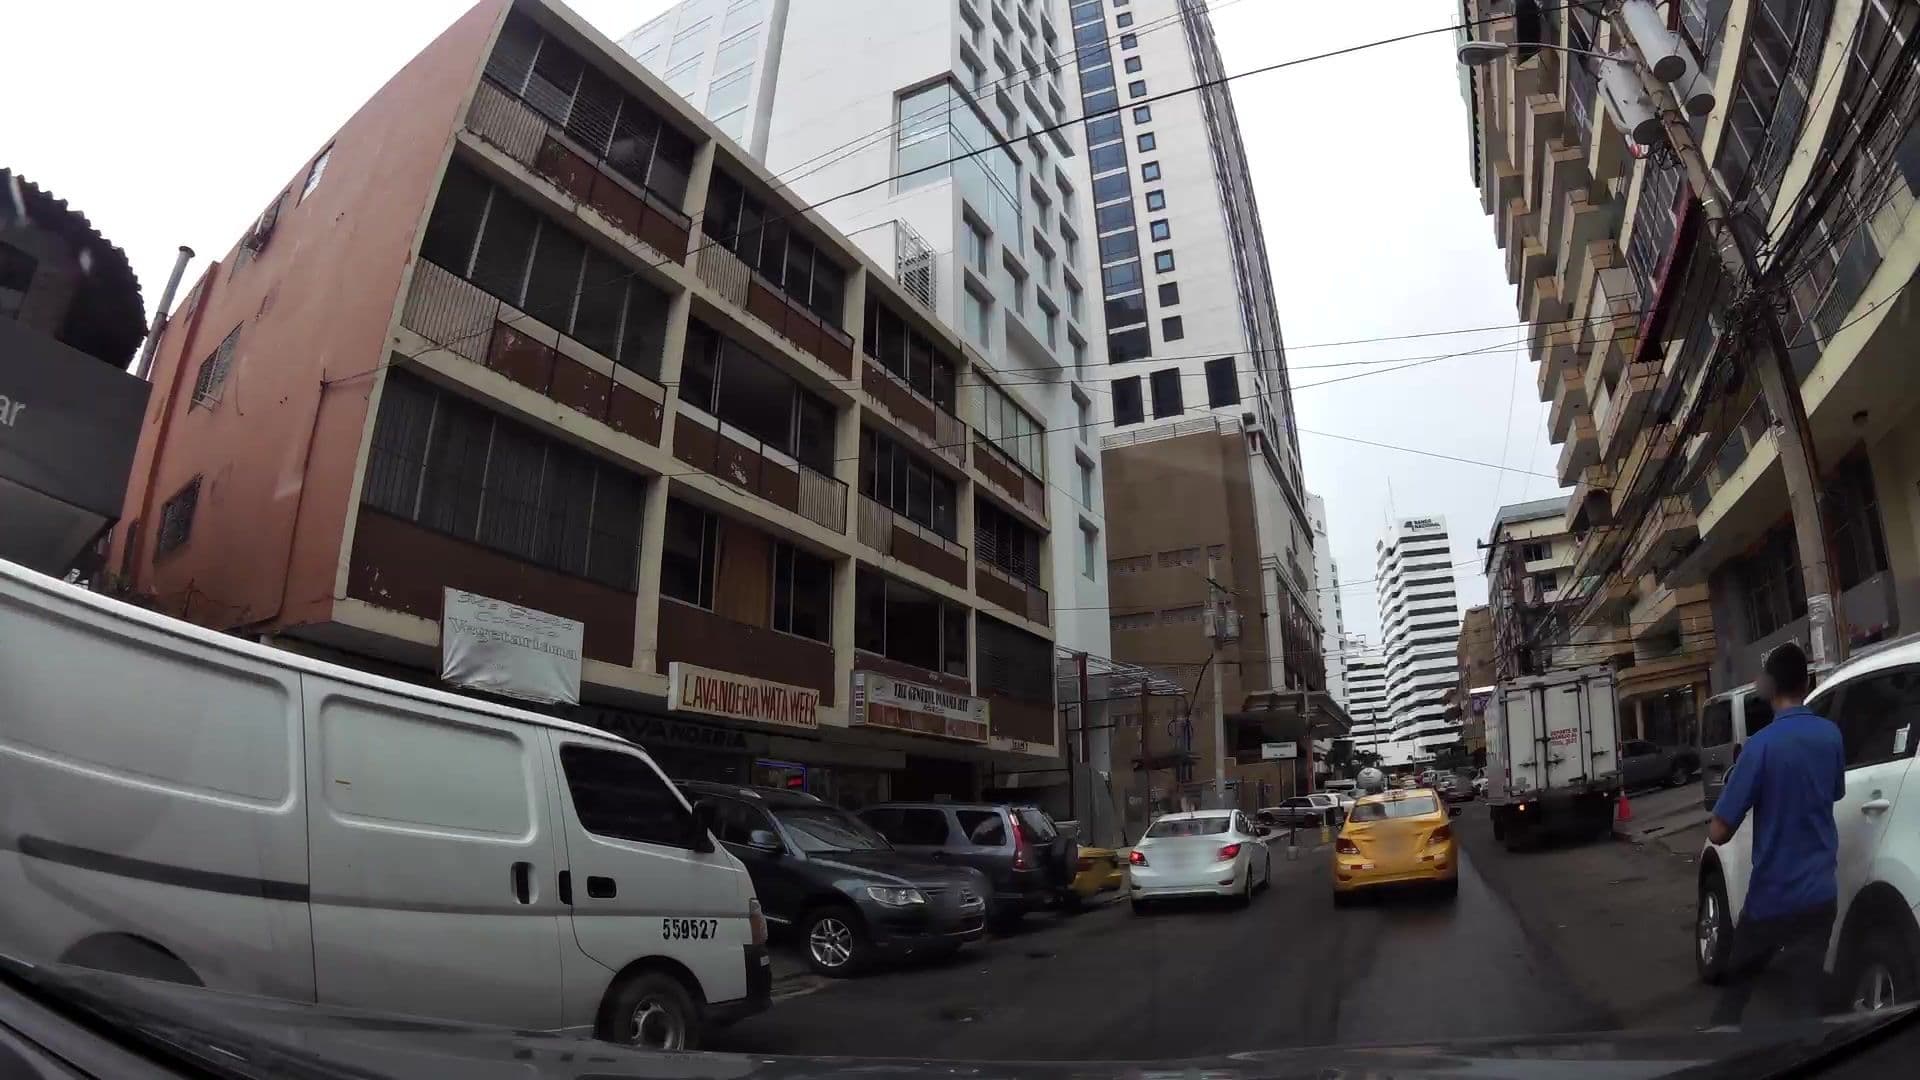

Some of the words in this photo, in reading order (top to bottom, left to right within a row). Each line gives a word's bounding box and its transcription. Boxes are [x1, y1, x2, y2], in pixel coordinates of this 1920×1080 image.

[682, 673, 760, 718] LAVANDERIA
[596, 712, 747, 747] LAVANDERIA
[662, 918, 719, 940] 559527
